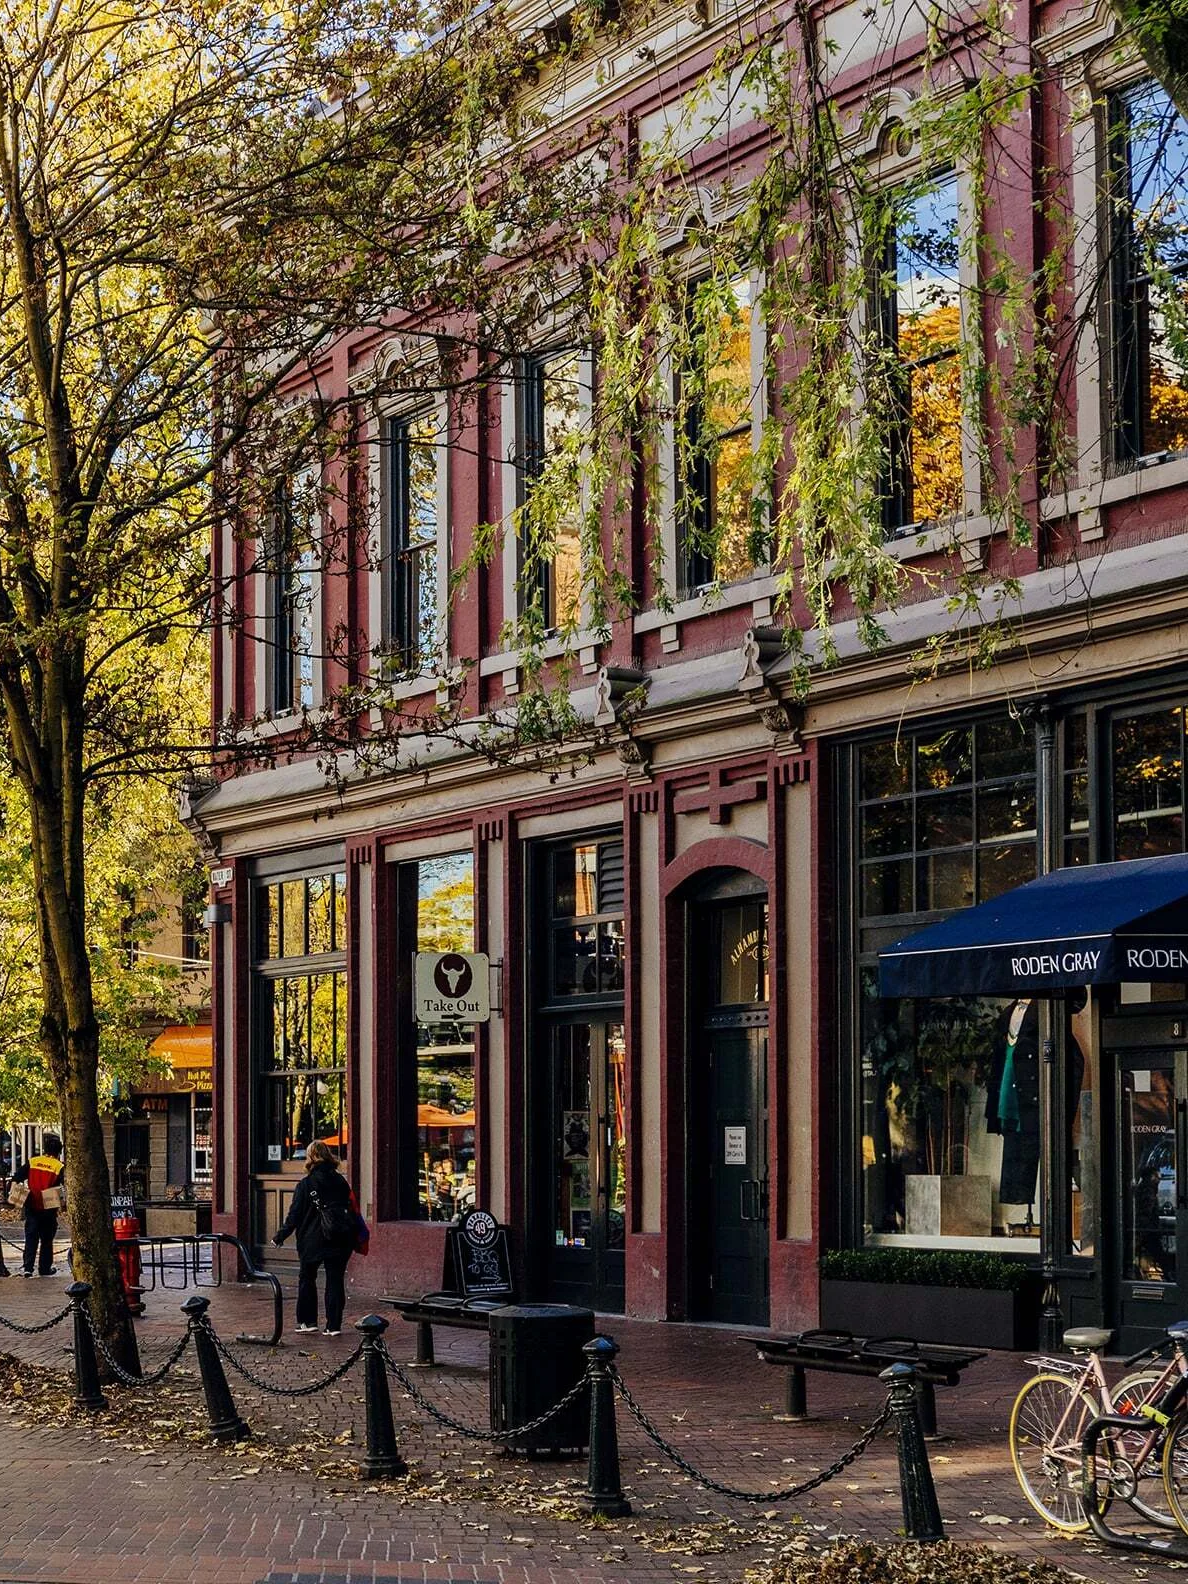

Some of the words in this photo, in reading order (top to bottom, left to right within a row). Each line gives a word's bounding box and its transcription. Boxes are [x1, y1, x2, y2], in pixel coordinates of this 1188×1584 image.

[731, 929, 768, 966] ALHAMBA
[1011, 955, 1059, 976] RODEN
[1062, 950, 1101, 973] GRAY
[424, 999, 453, 1011] Take
[457, 999, 480, 1012] Out
[142, 1099, 168, 1110] ATM
[475, 1222, 486, 1234] 49
